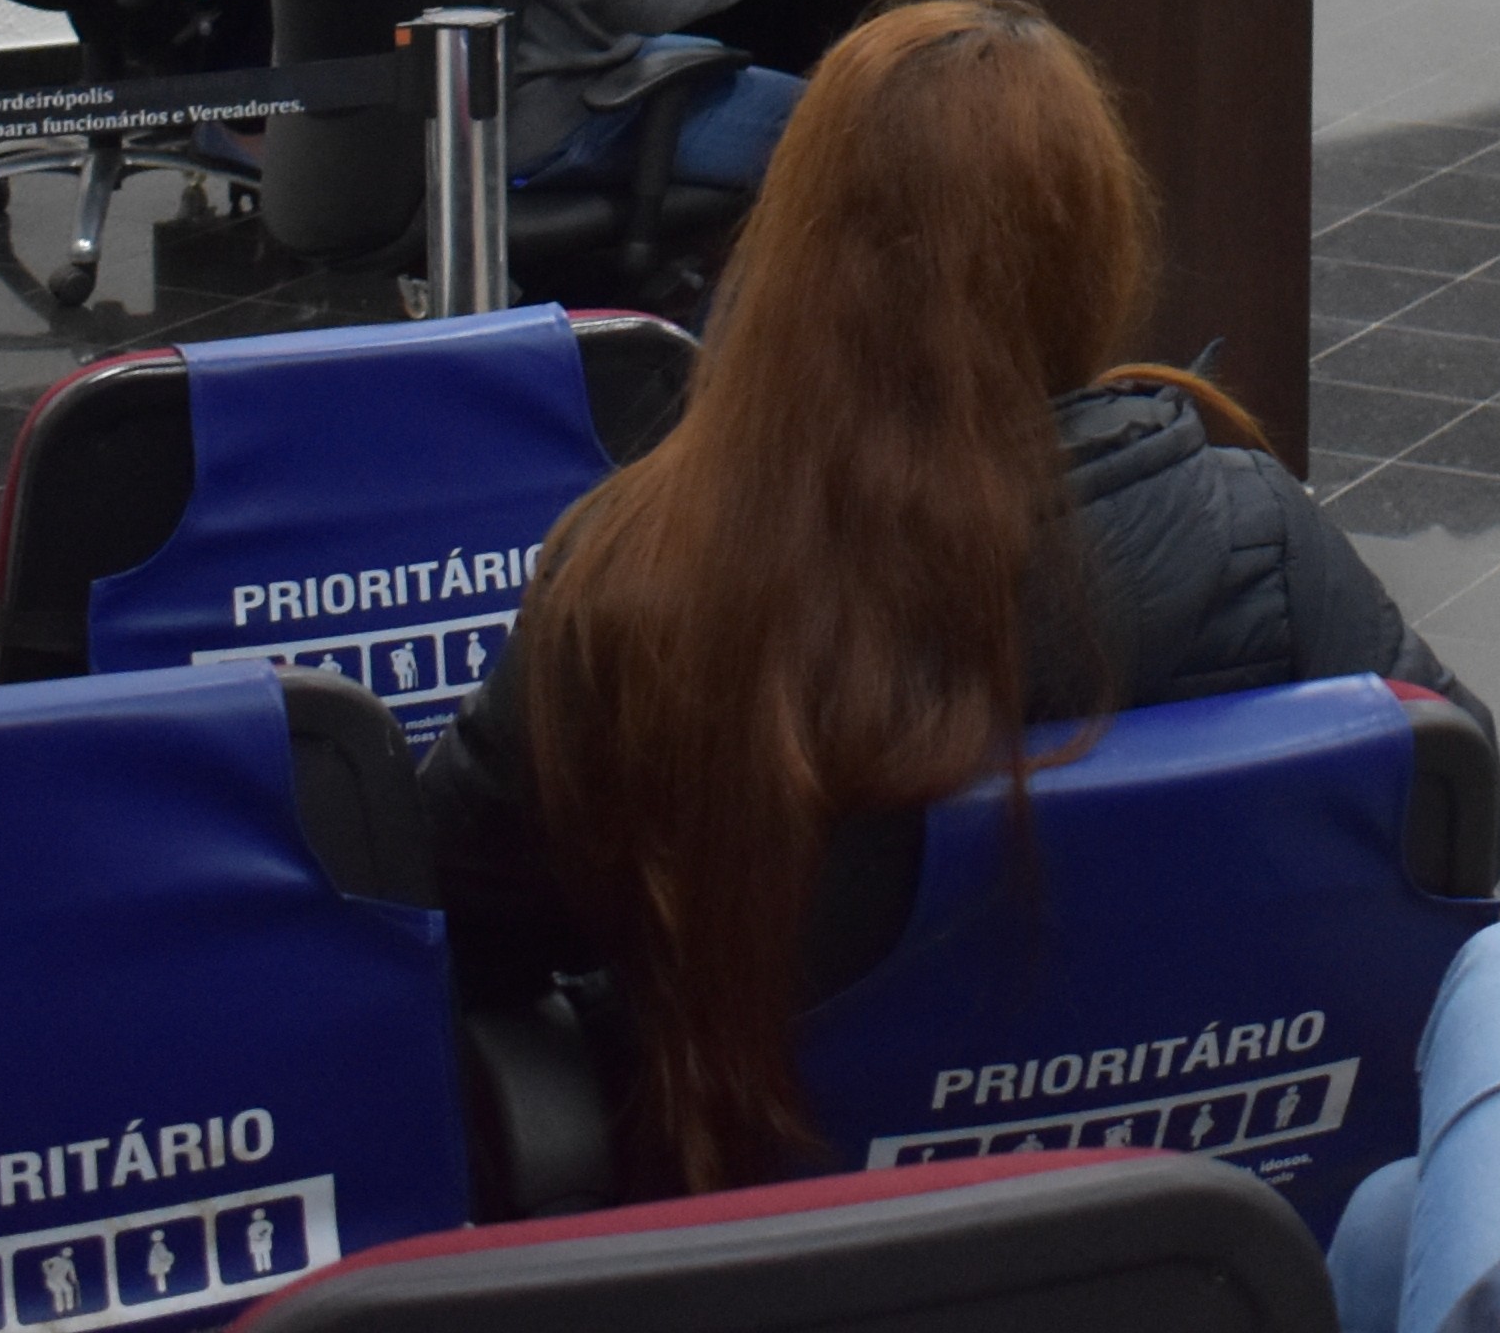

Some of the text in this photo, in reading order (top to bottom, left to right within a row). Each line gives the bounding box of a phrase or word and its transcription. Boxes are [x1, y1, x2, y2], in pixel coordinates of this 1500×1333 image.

[42, 108, 168, 134] funcionários
[172, 110, 186, 125] e
[187, 98, 306, 122] Vereadores.
[931, 1009, 1325, 1111] PRIORITÁRIO
